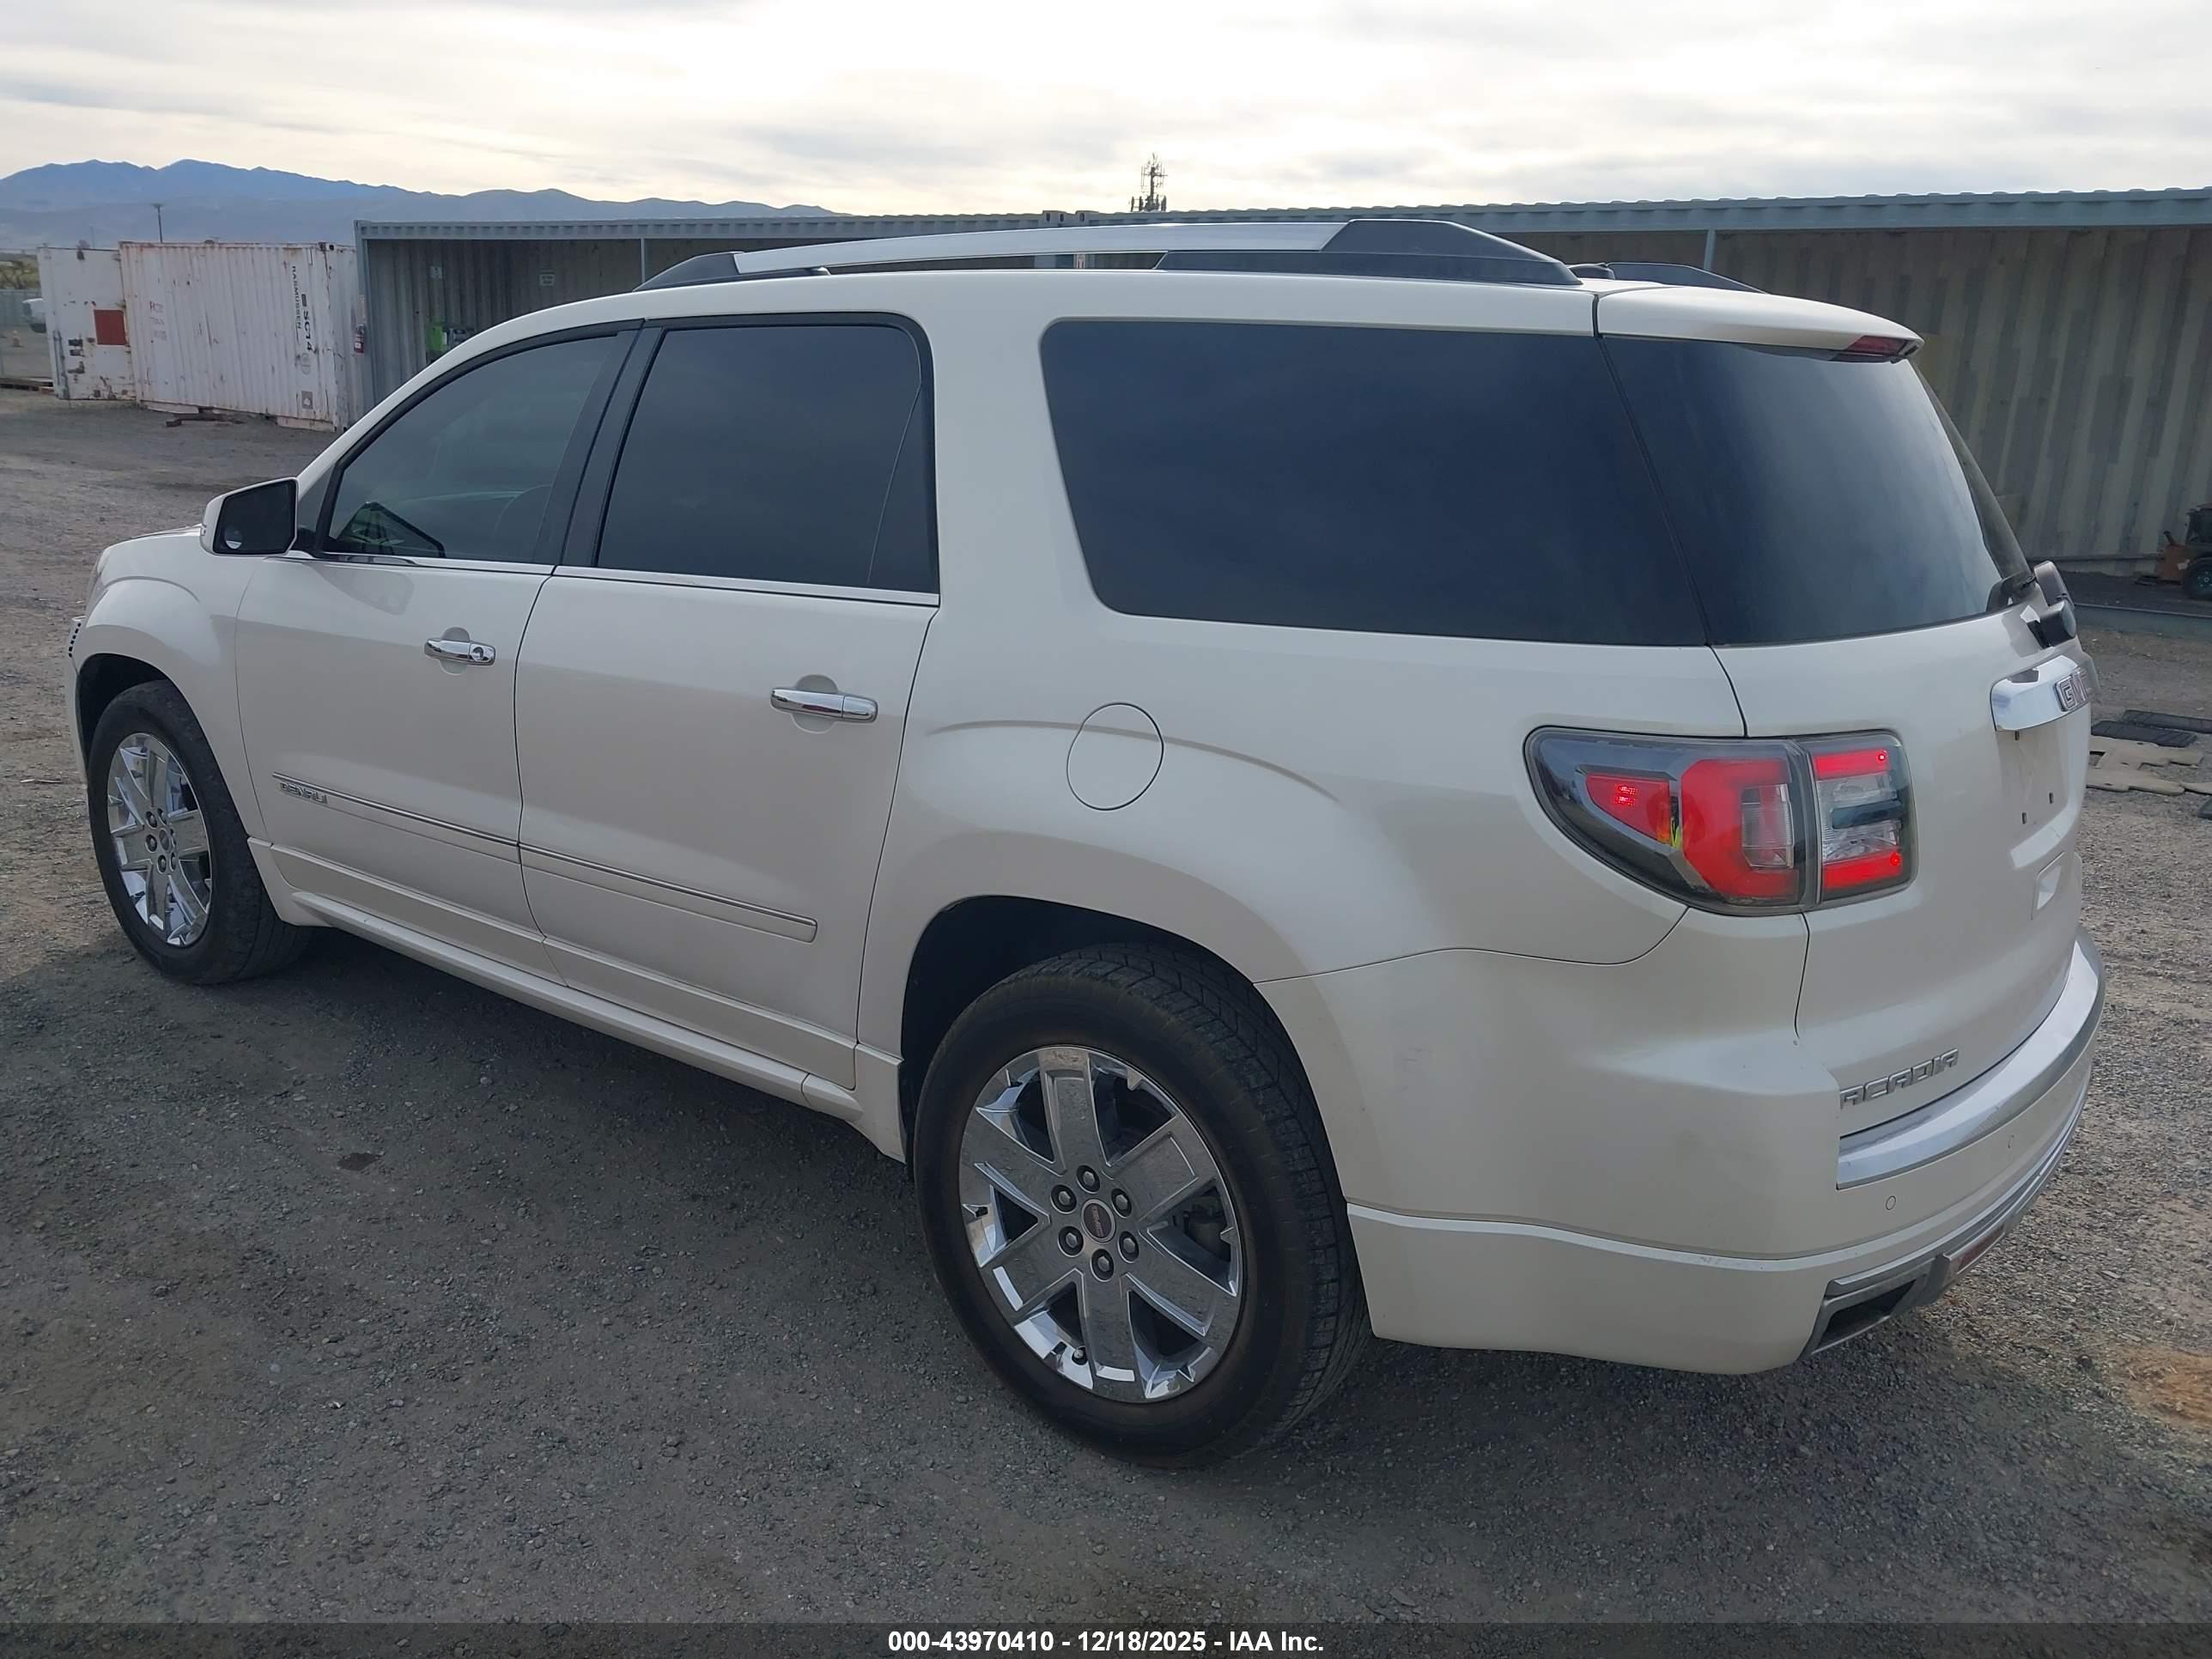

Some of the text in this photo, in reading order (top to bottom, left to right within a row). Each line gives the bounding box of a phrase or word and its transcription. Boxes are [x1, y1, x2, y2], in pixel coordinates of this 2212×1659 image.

[292, 265, 301, 330] RASMUSSEN
[279, 781, 328, 805] DENALI
[1840, 1048, 1959, 1109] ACADIA
